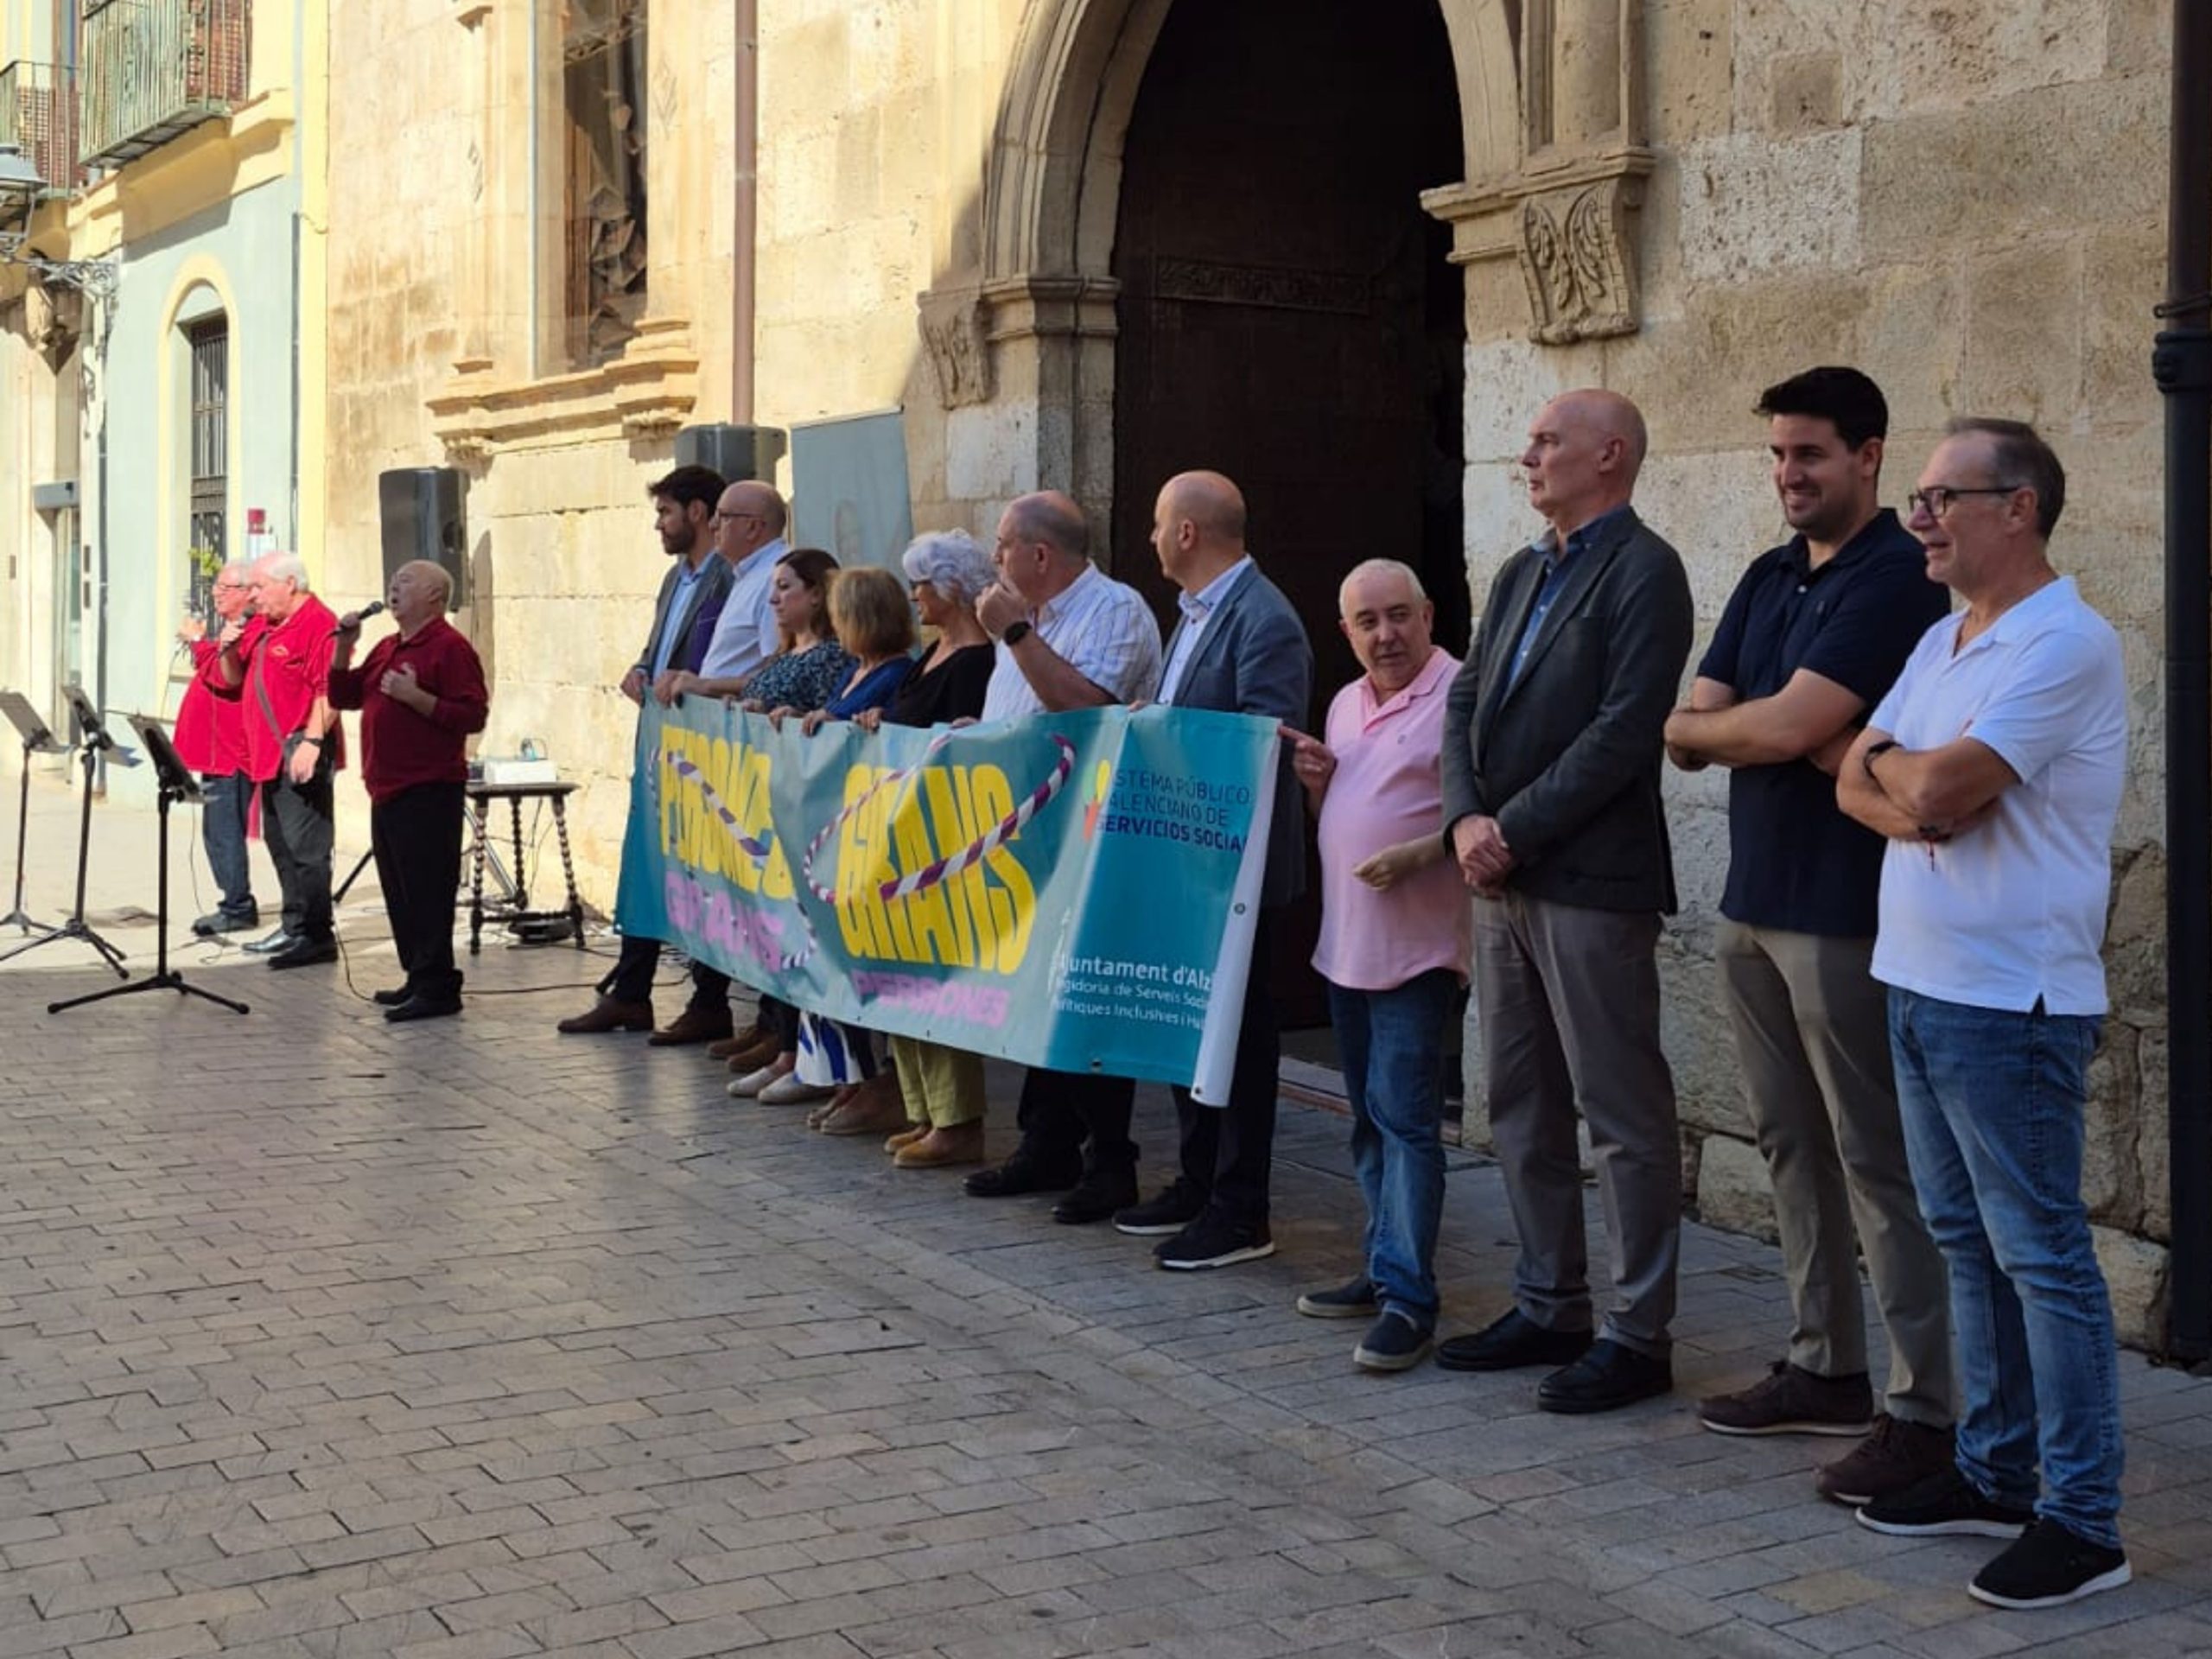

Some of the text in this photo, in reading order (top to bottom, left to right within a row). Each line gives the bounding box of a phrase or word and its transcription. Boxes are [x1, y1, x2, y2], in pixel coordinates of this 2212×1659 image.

[1113, 768, 1250, 804] STEMA PÚBLICO
[1109, 791, 1230, 827] ALENCIANO DE
[835, 763, 1036, 975] GRANS
[1058, 977, 1110, 995] gidoria
[1114, 982, 1132, 995] de
[1136, 984, 1181, 1005] Serveis
[1173, 964, 1211, 992] d'Alz
[850, 969, 1009, 1029] PERSONES
